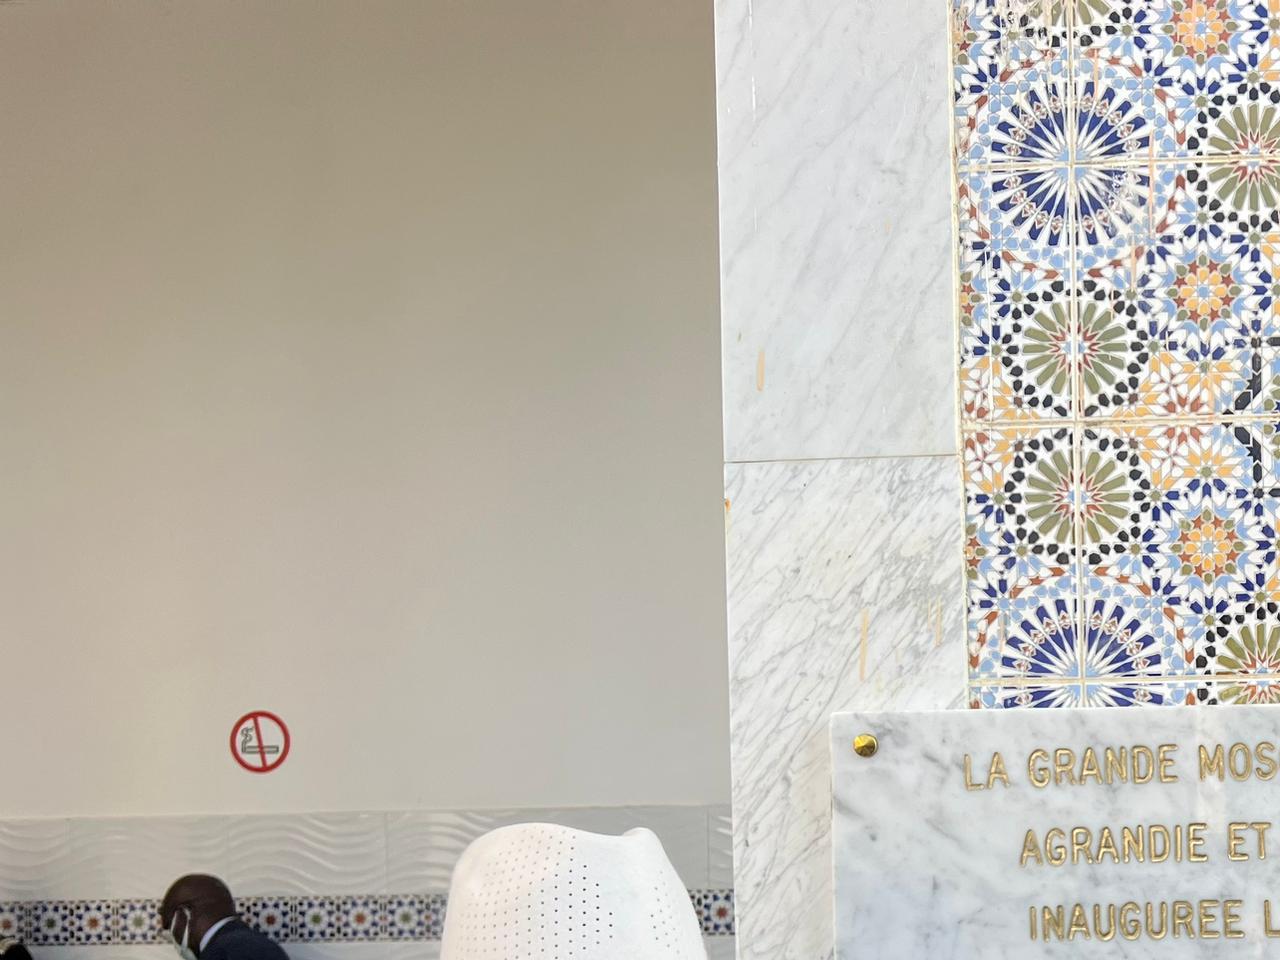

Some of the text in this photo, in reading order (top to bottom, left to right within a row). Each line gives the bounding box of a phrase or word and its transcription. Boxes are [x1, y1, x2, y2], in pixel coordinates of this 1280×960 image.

[963, 751, 1010, 791] LA
[1028, 743, 1179, 789] GRANDE
[1020, 822, 1209, 868] AGRANDIE
[1227, 821, 1272, 862] ET
[1029, 899, 1247, 942] INAUGUREE
